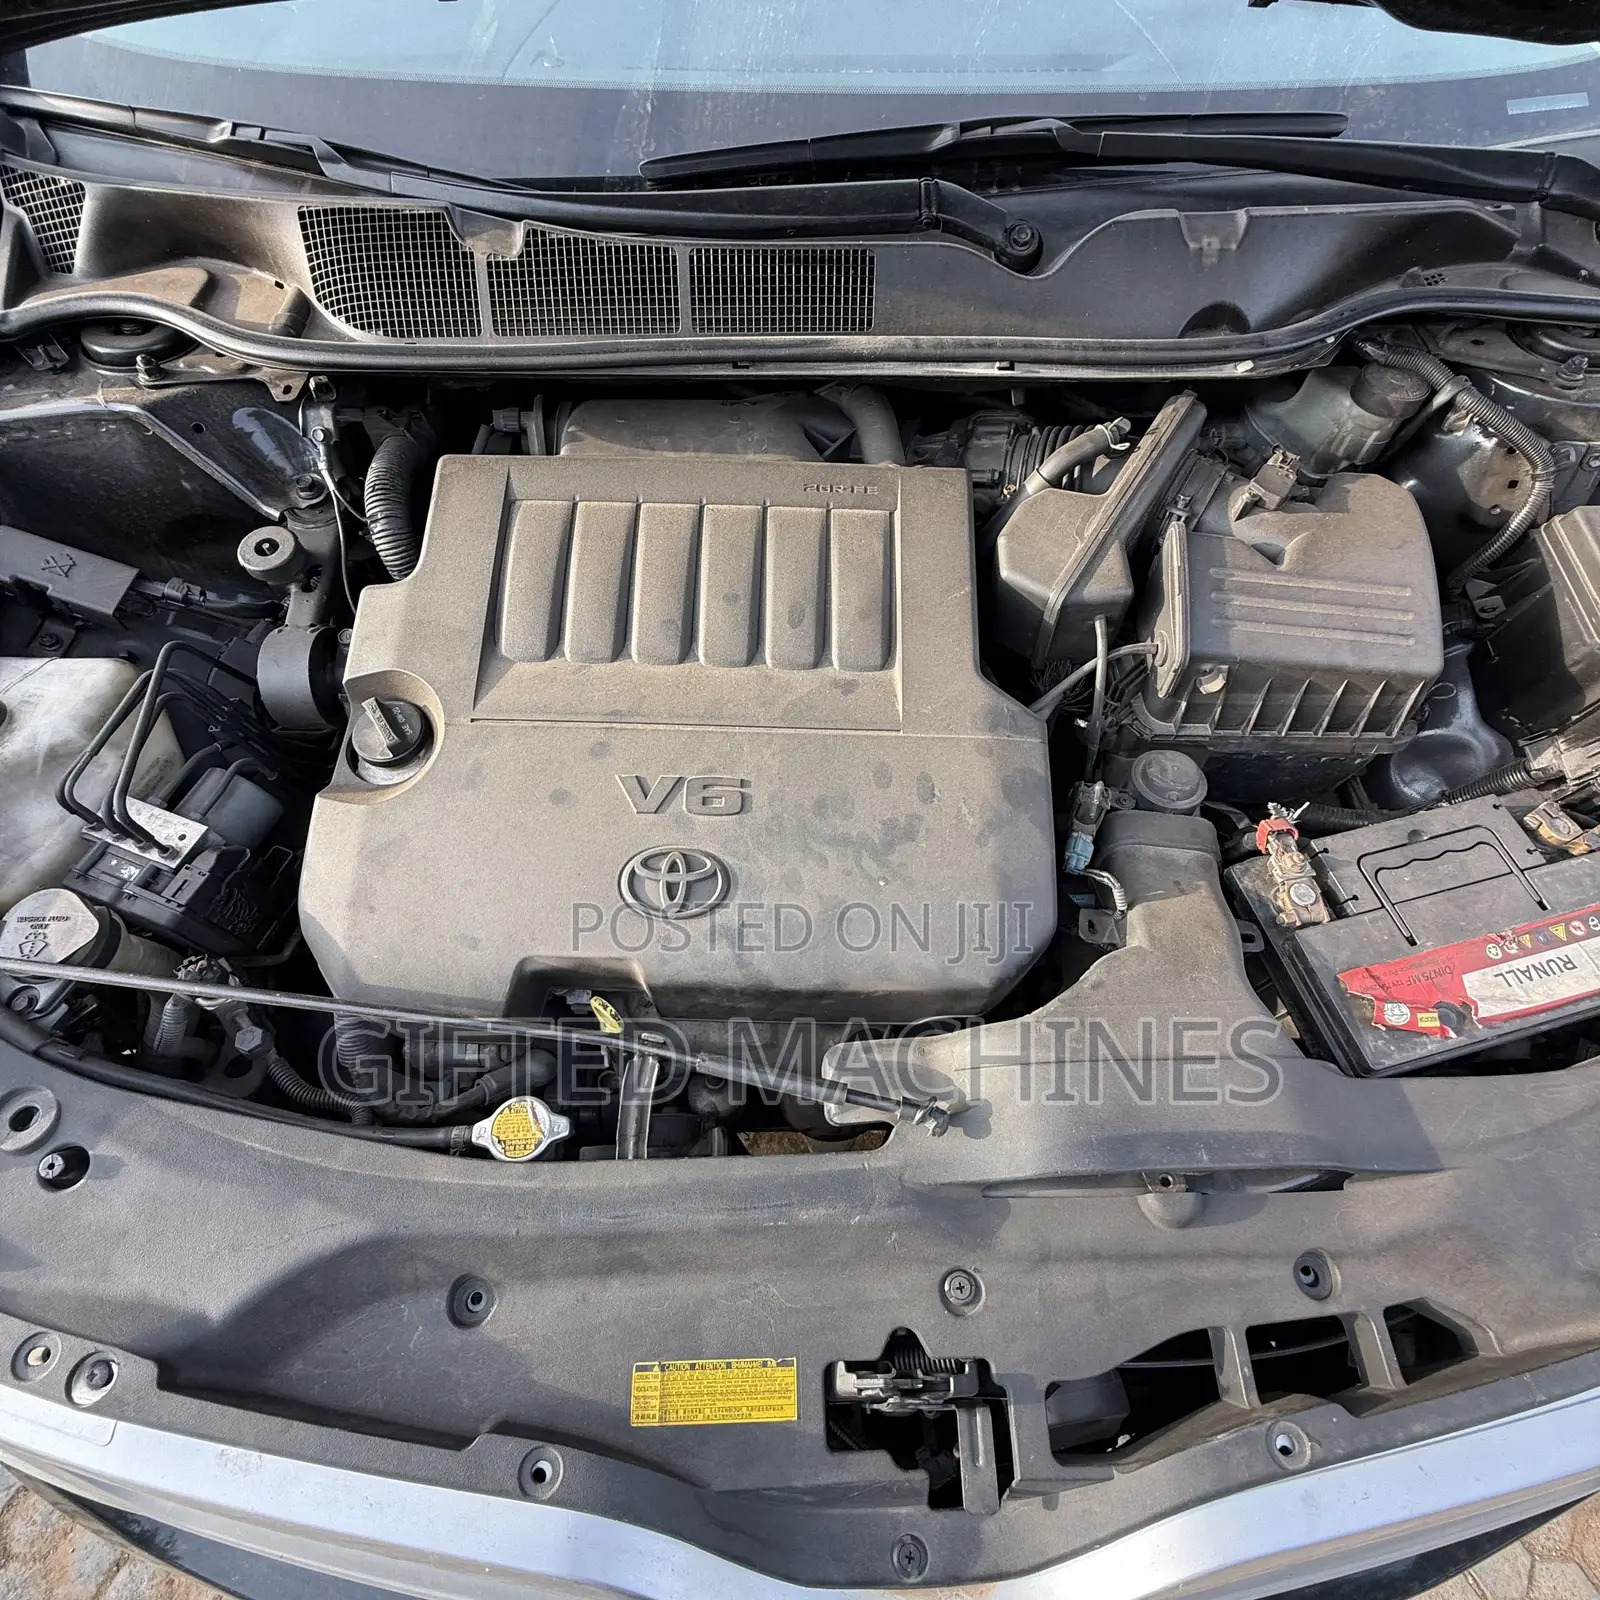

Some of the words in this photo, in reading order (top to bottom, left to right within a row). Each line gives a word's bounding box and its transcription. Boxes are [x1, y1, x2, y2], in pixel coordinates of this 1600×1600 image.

[803, 483, 879, 495] 2GR-FE
[401, 723, 413, 736] SAE
[615, 774, 751, 816] V6
[1422, 964, 1452, 983] DIN75
[1493, 954, 1578, 987] RUNALL
[664, 1363, 691, 1371] CAUTION
[694, 1361, 727, 1370] ATTENTION
